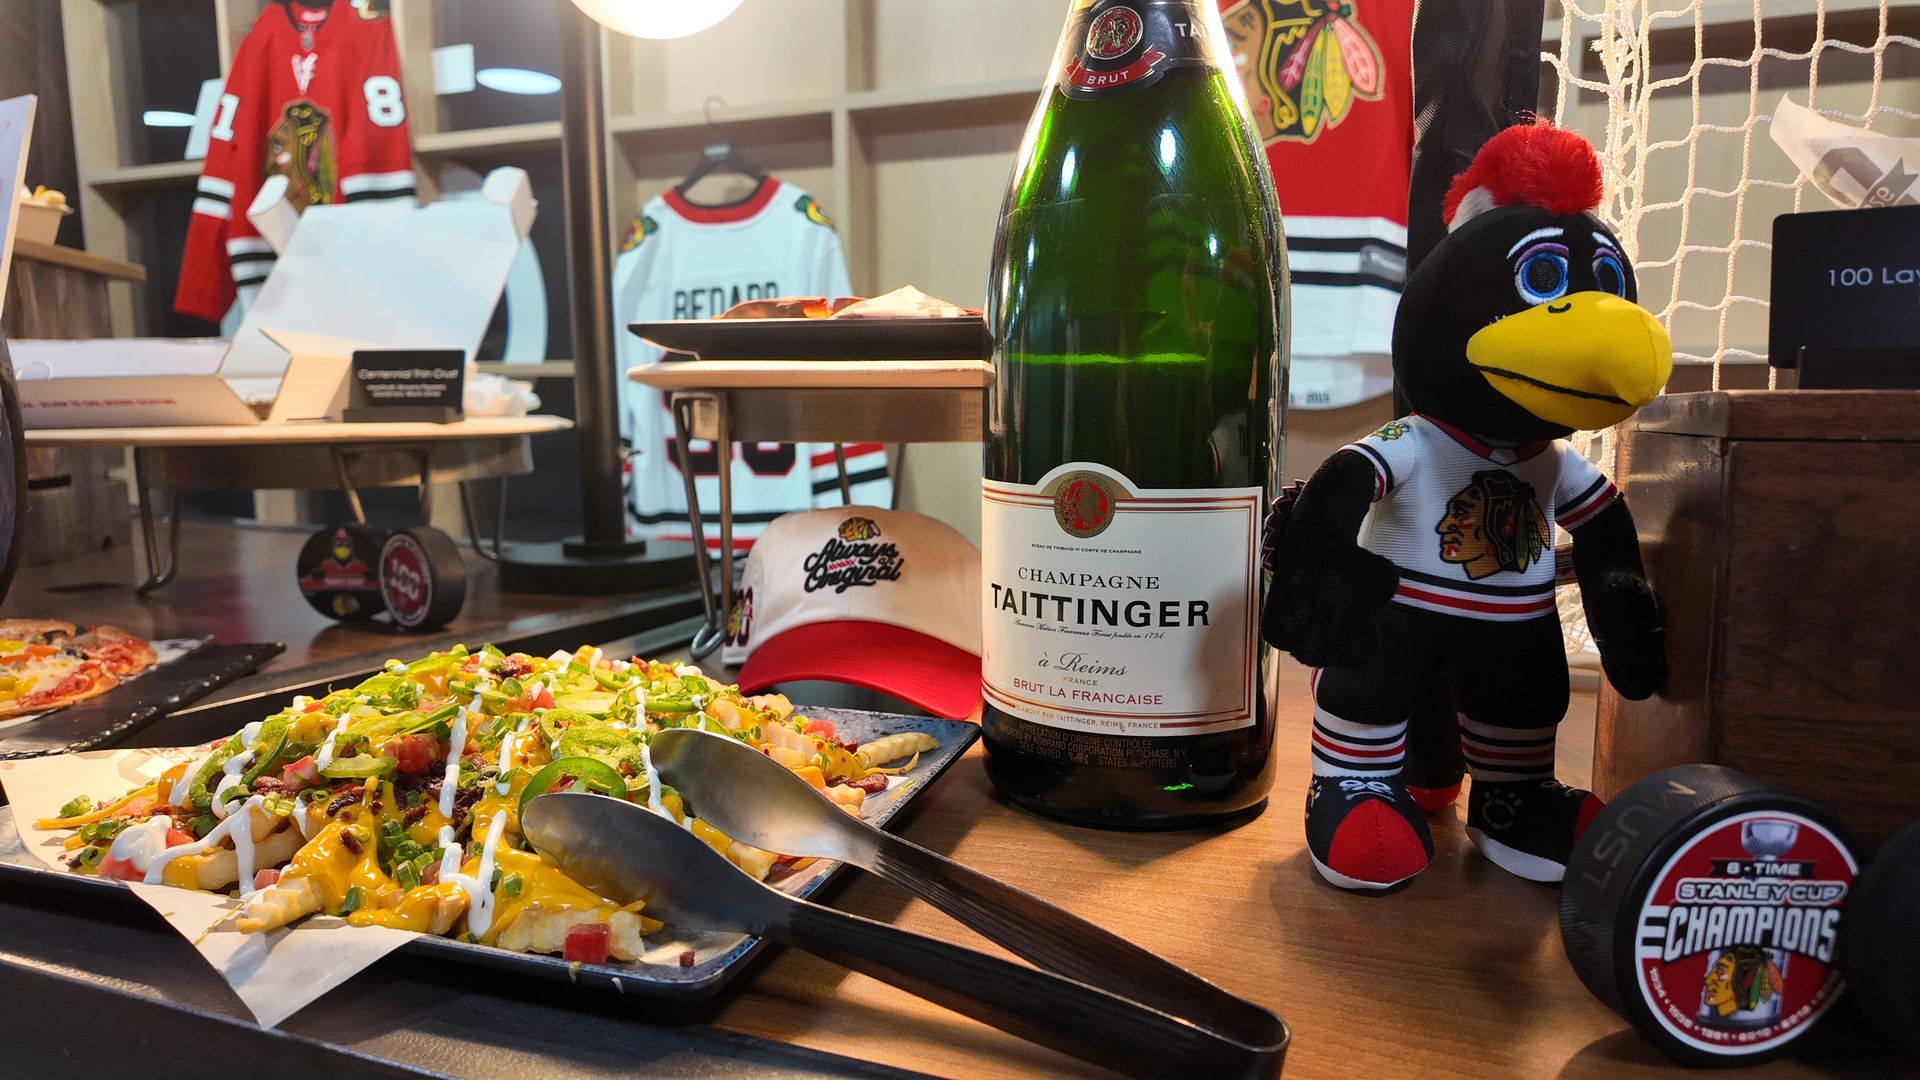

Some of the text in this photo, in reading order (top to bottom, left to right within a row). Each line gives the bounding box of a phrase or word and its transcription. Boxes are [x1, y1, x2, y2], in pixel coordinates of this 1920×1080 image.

[1086, 70, 1129, 85] BRUT
[363, 75, 405, 127] 8
[1828, 267, 1873, 286] 100
[803, 537, 899, 573] Always
[803, 557, 905, 594] Original
[1018, 566, 1160, 590] CHAMPAGNE
[991, 582, 1209, 628] TAITTINGER
[1144, 631, 1165, 640] 1734
[1038, 651, 1128, 676] à Reims
[1013, 677, 1163, 705] BRUT LA FRANCAISE
[1062, 676, 1098, 687] FRANCE
[1056, 713, 1098, 727] TAITTINGER,
[1127, 721, 1159, 729] FRANCE
[1018, 722, 1061, 740] APPELLATION
[1062, 731, 1101, 748] D'ORIGINE
[1033, 735, 1067, 750] KOBRAND
[1068, 742, 1124, 758] CORPORATION
[1036, 744, 1061, 759] UNITED
[1097, 755, 1129, 768] STATES
[1130, 756, 1177, 769] IMPORTERS
[1678, 882, 1844, 901] STANLEY CUP
[1662, 905, 1842, 963] CHAMPIONS
